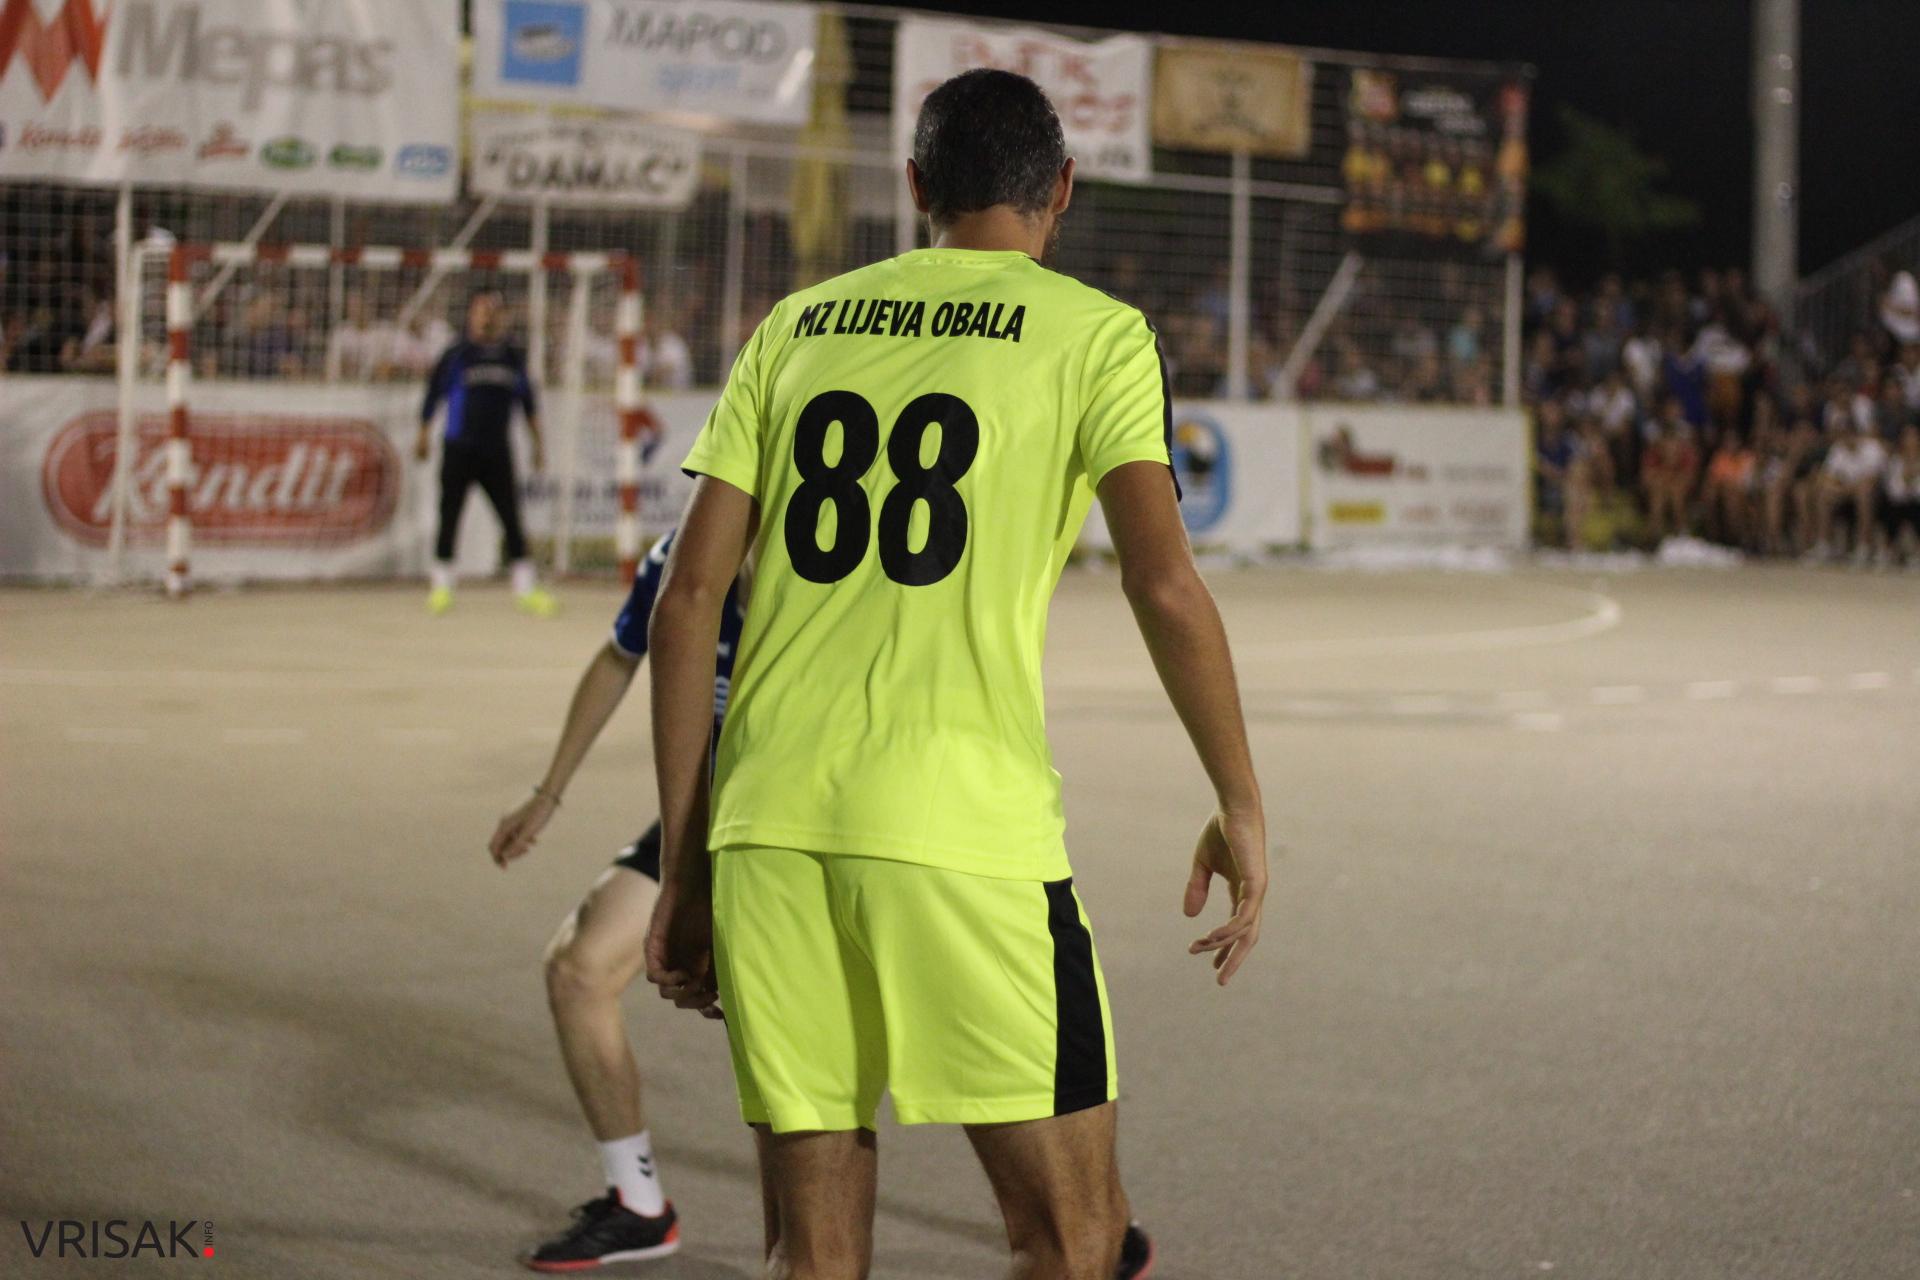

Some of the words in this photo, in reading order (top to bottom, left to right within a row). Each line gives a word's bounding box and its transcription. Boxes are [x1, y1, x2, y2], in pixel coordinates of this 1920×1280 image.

[118, 1, 397, 111] Mepas
[793, 300, 836, 339] MZ
[833, 299, 926, 337] LIJEVA
[931, 302, 1026, 343] OBALA
[784, 390, 979, 586] 88
